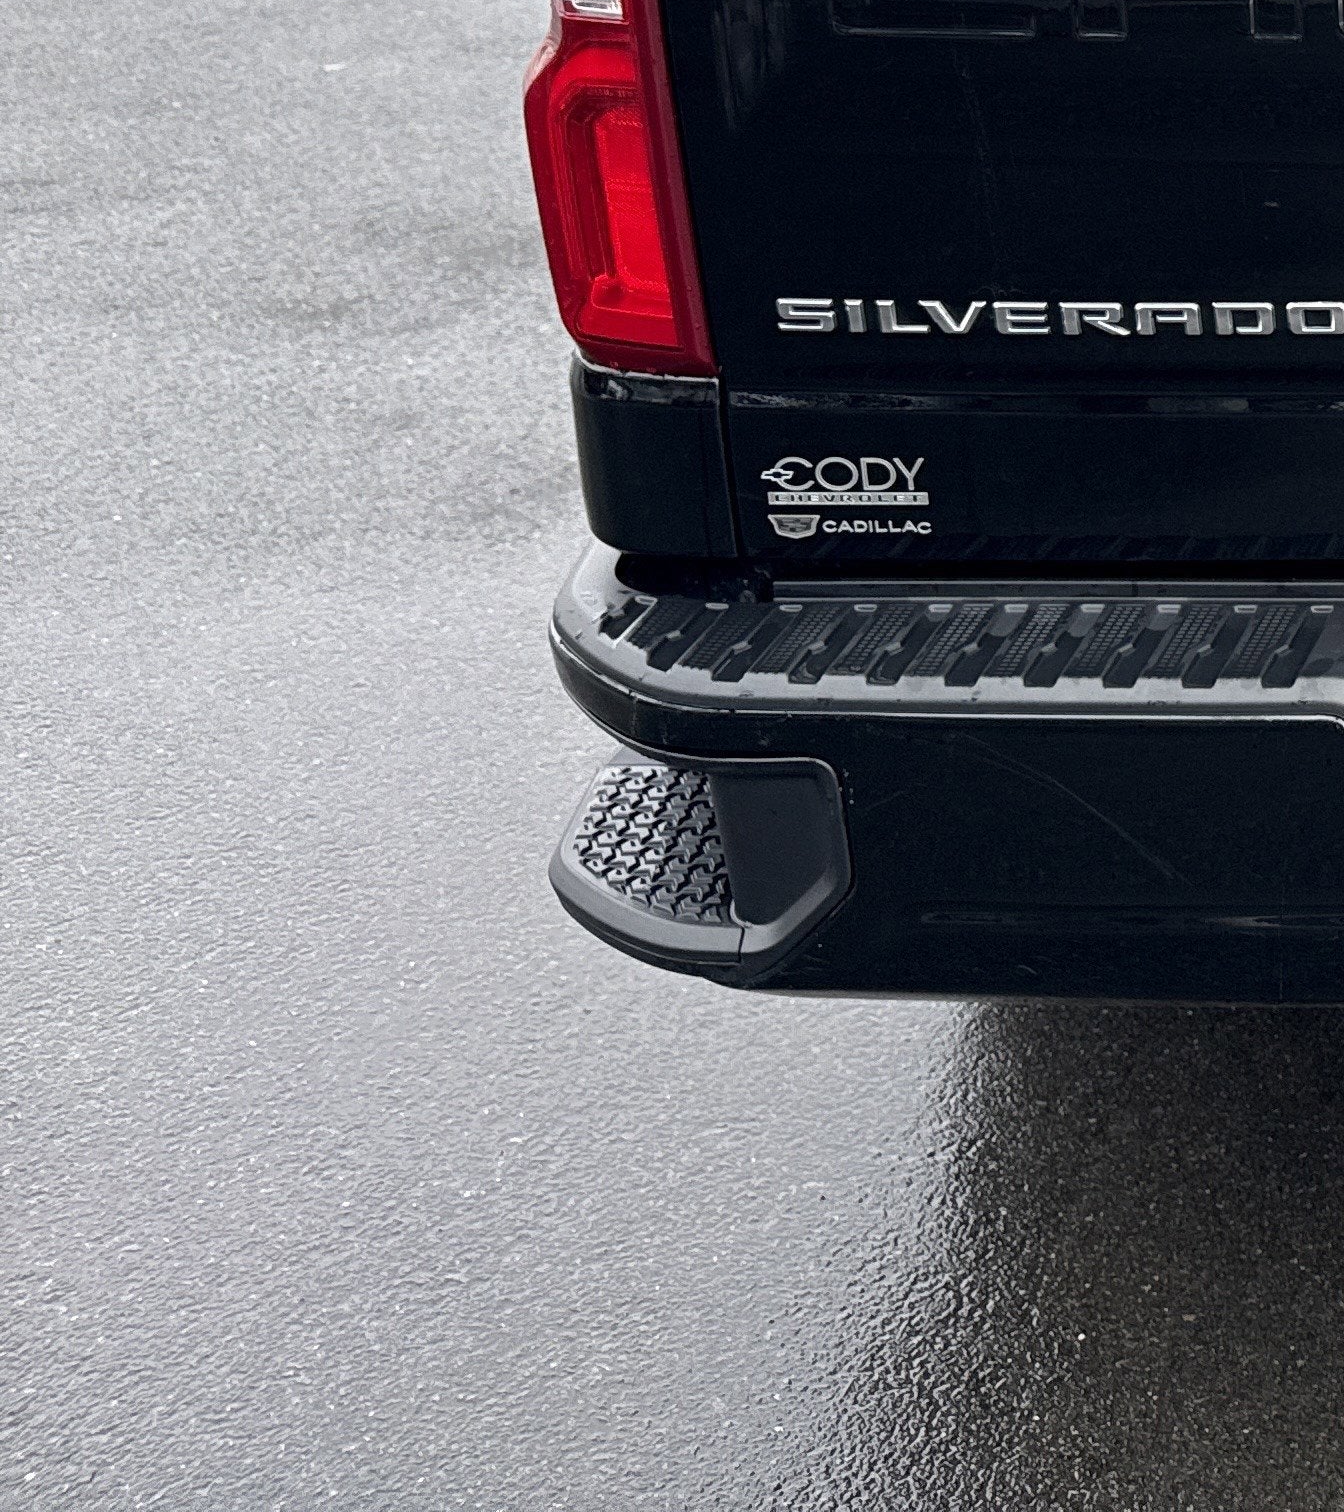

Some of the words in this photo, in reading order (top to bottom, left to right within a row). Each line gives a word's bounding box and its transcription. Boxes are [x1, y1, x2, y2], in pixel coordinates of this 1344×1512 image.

[768, 456, 925, 491] CODY
[772, 493, 925, 504] CHEVROLET
[822, 519, 932, 535] CADILLAC
